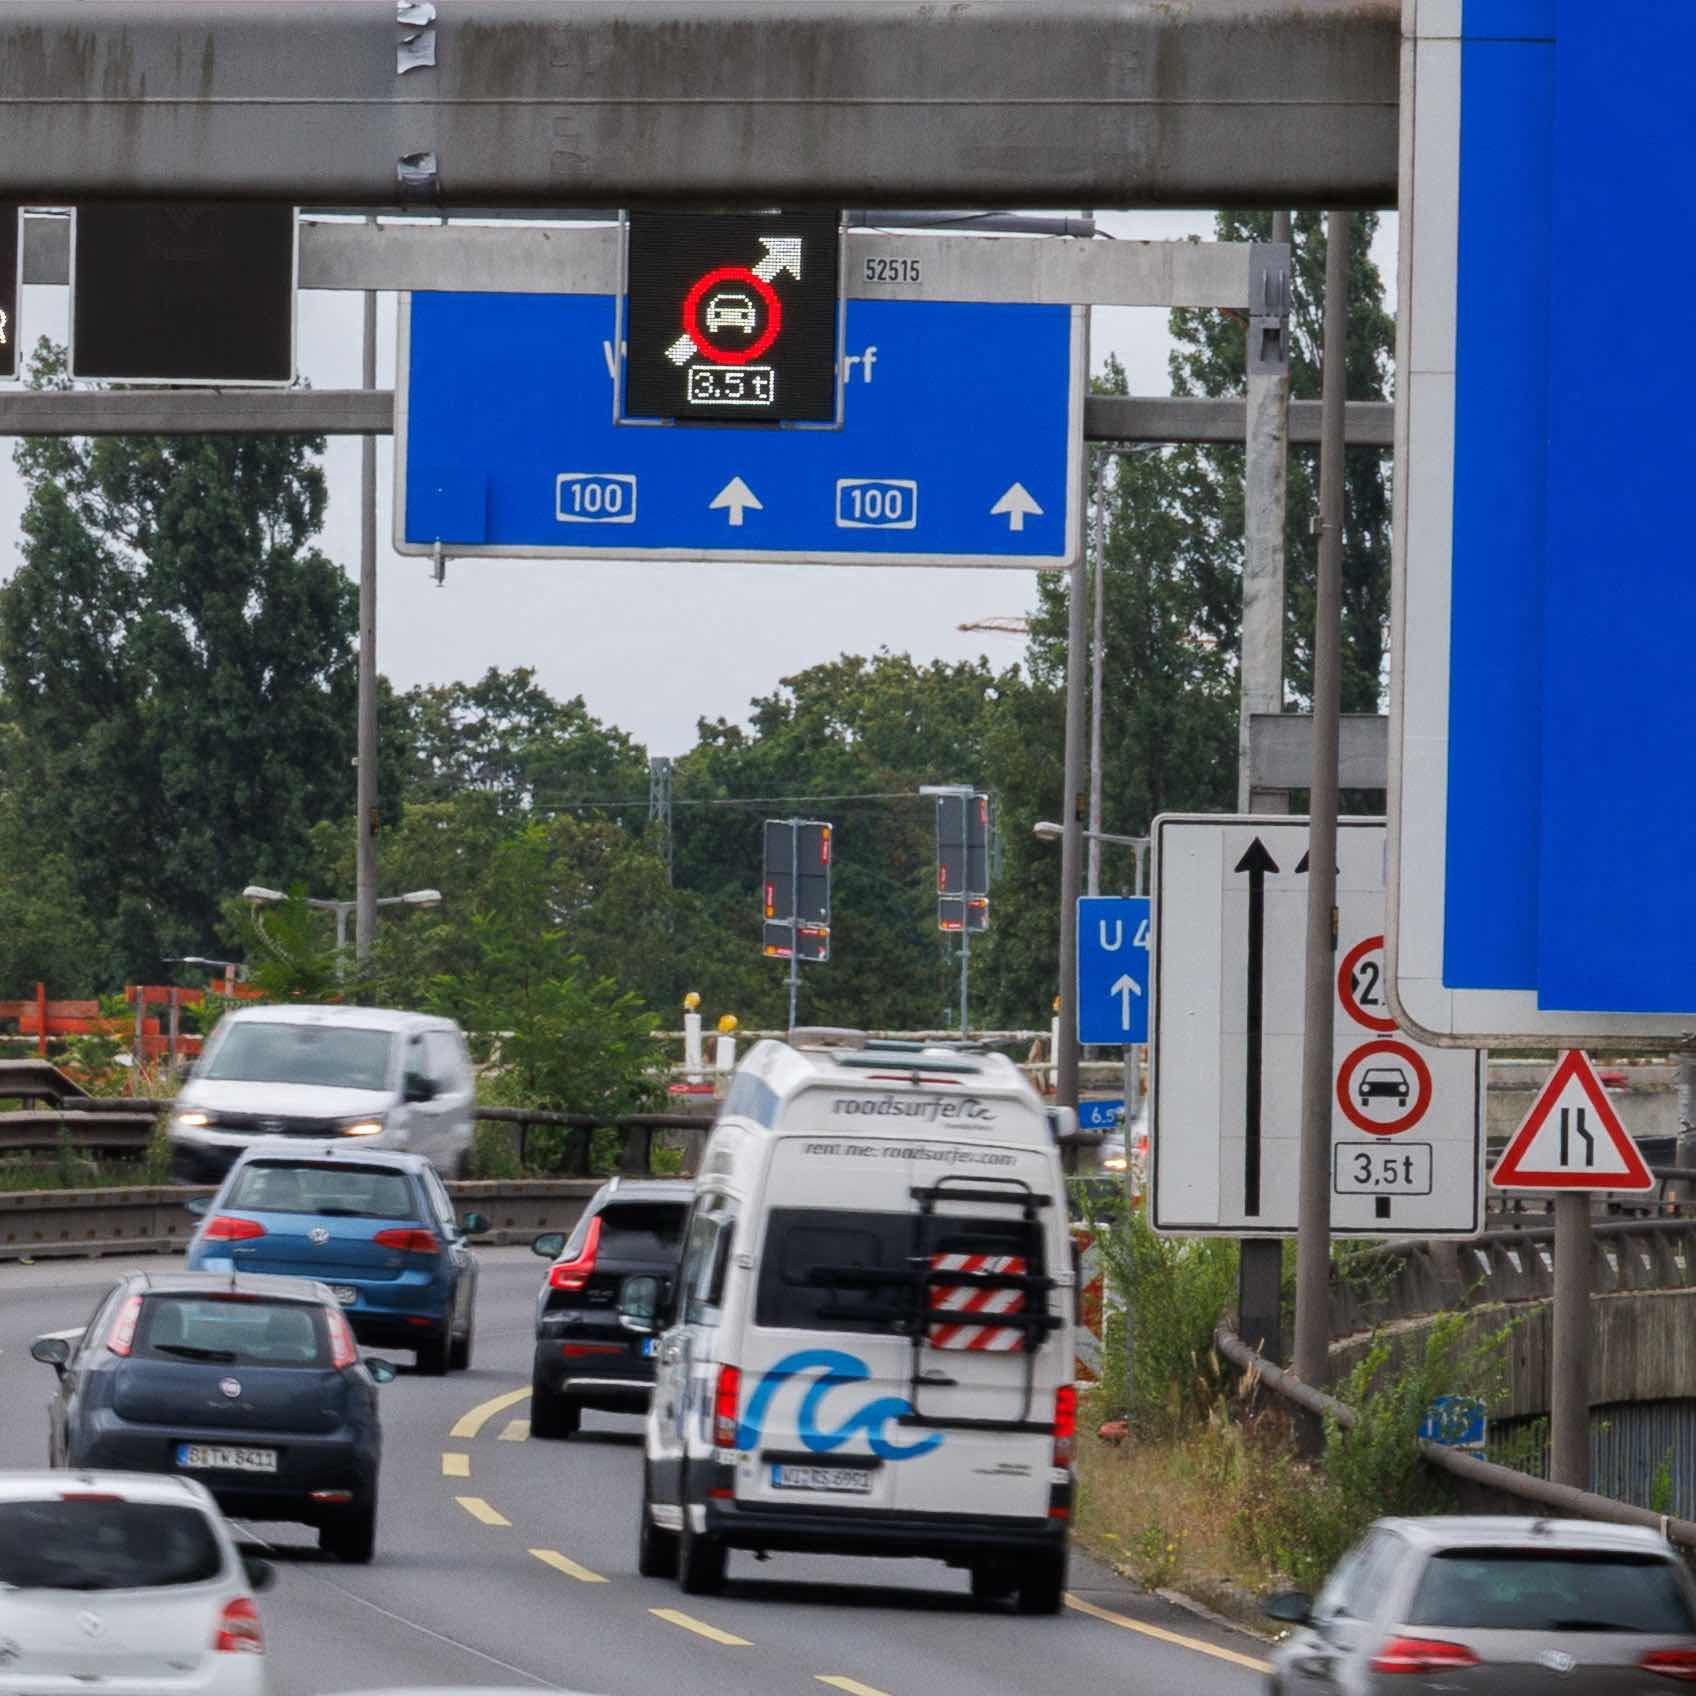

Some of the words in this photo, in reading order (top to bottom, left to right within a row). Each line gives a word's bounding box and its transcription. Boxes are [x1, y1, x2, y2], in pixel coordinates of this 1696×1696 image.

[866, 258, 920, 281] 52515
[570, 482, 623, 514] 100
[851, 489, 903, 521] 100
